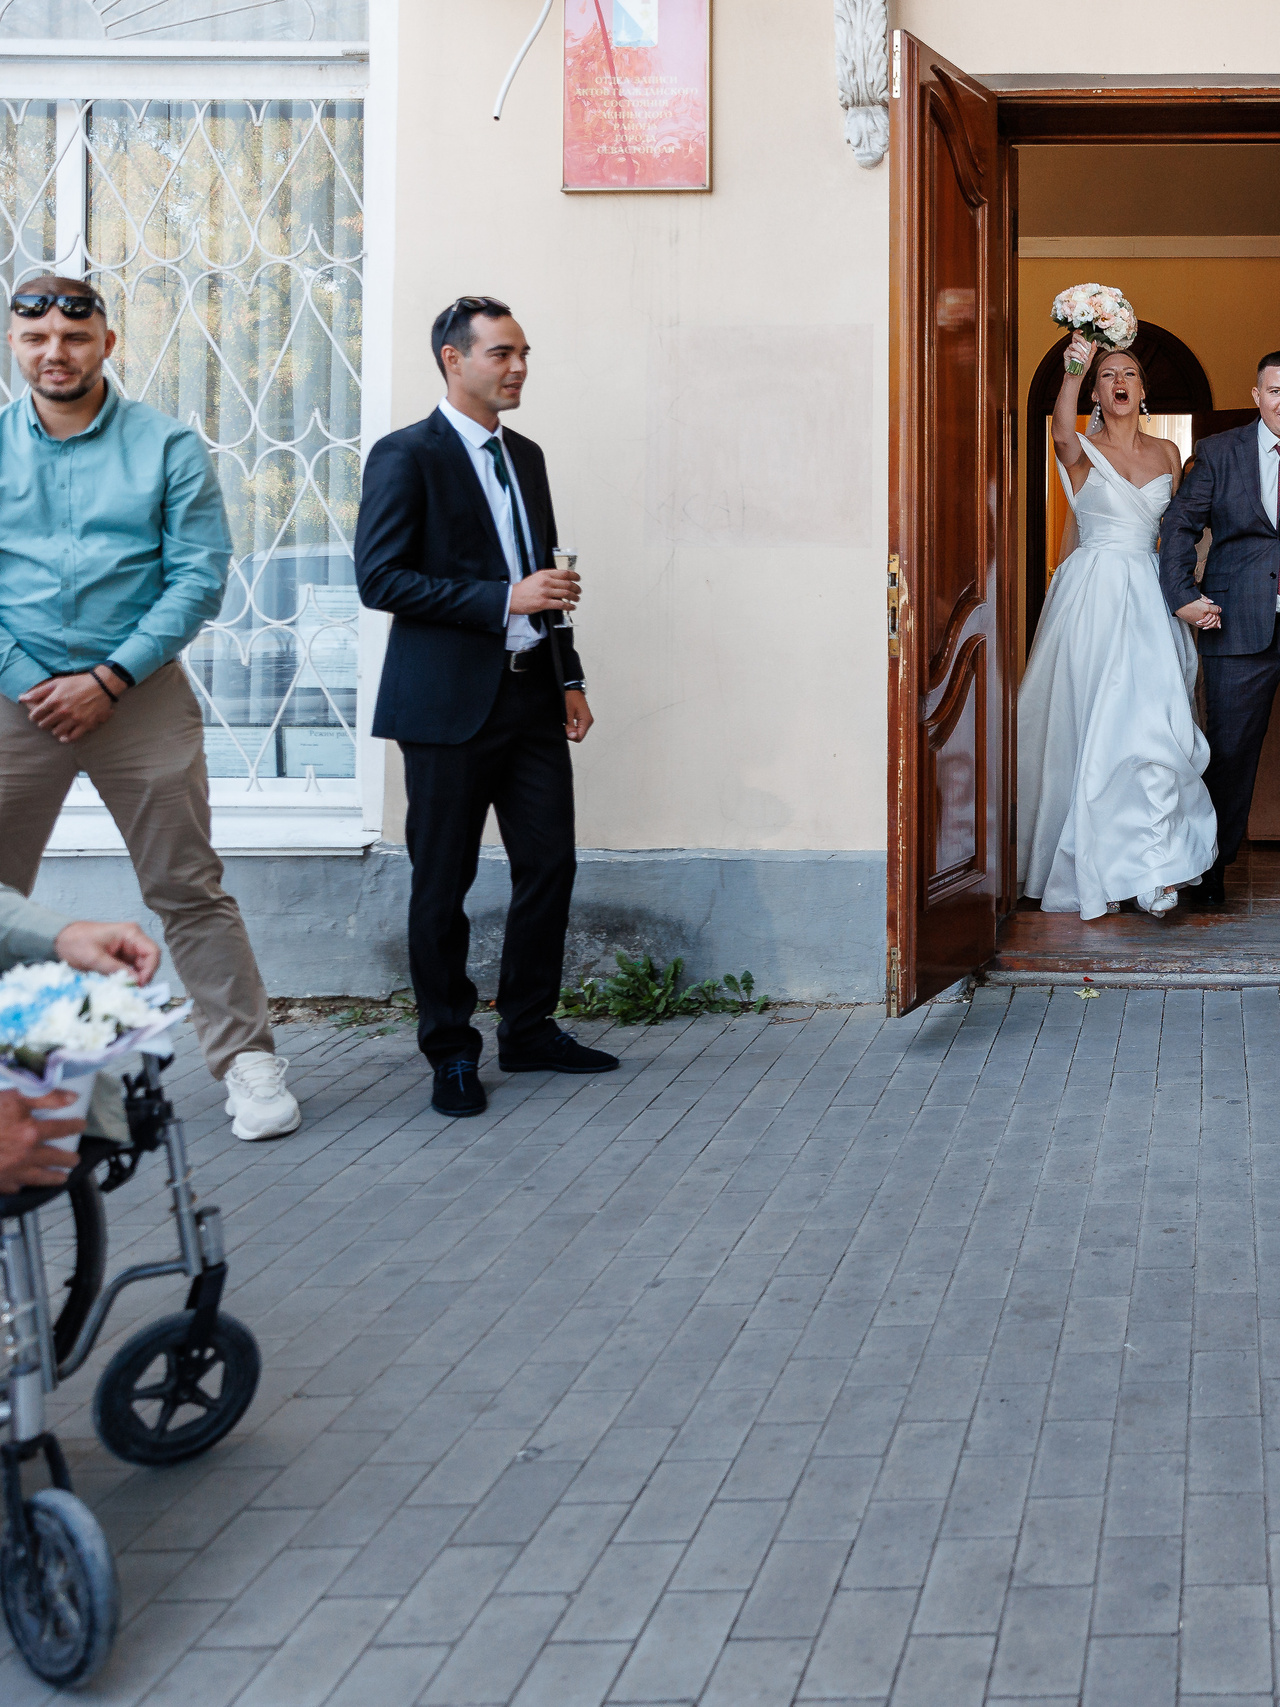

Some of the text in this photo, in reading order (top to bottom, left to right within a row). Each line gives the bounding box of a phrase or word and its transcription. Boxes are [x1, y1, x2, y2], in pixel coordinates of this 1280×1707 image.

[594, 76, 677, 86] ОТДЕЛ ЗАПИСИ
[575, 88, 698, 97] АКТОВ ГРАЖДАНСКОГО
[603, 99, 669, 107] СОСТОЯНИЯ
[601, 111, 673, 119] ЛЕНИНСКОГО
[613, 121, 658, 131] РАЙОНА
[615, 134, 657, 143] ГОРОДА
[596, 145, 675, 154] СЕВАСТОПОЛЯ
